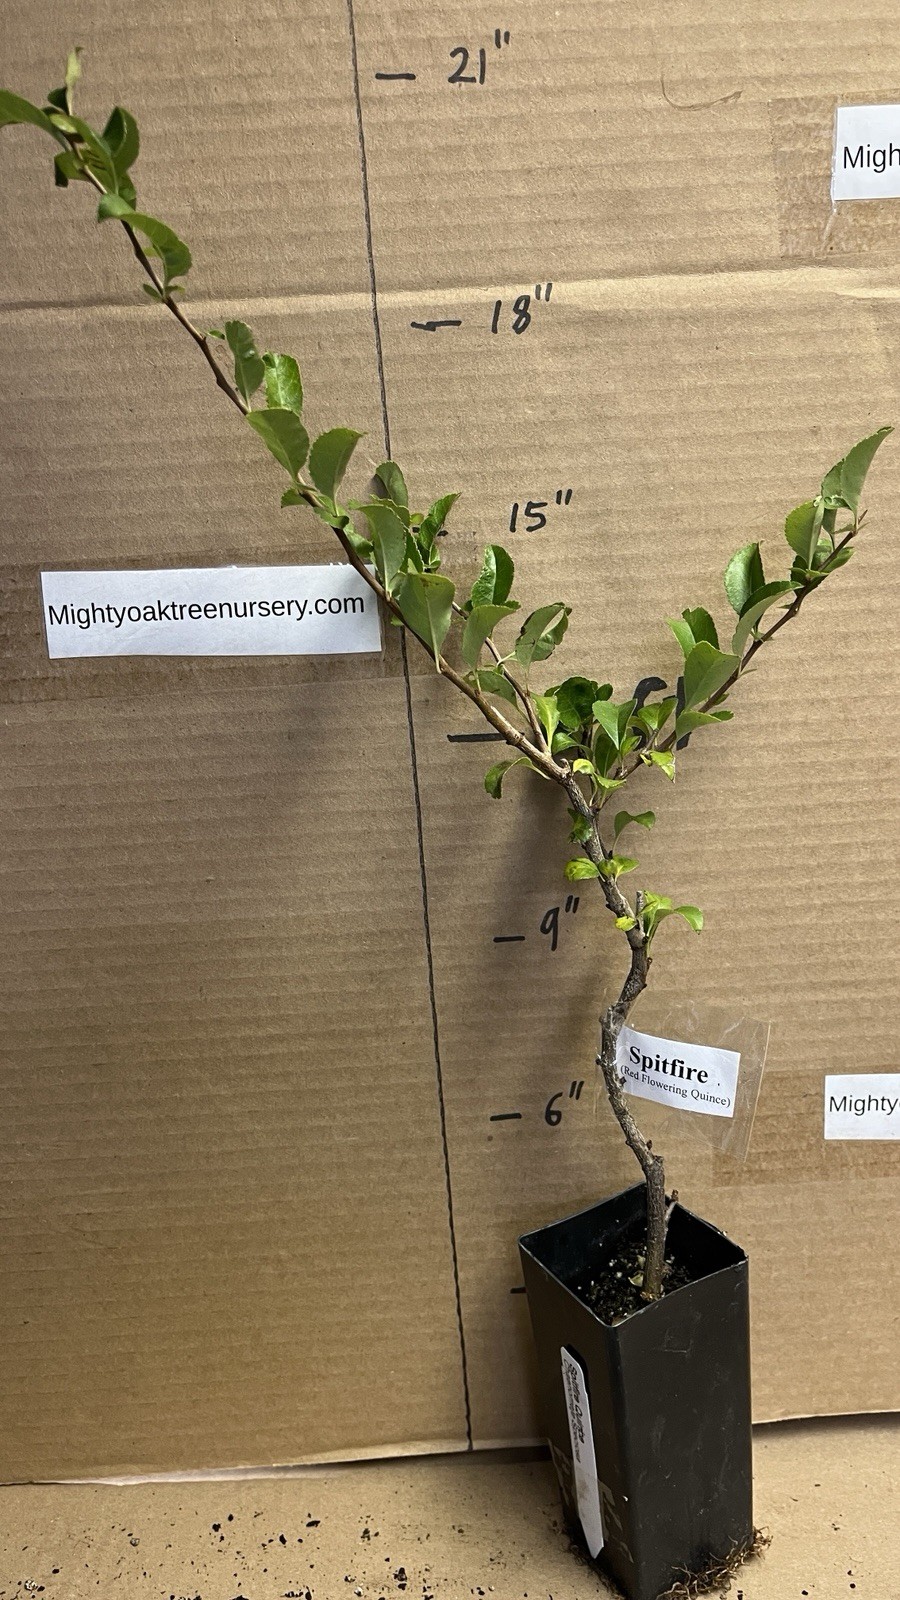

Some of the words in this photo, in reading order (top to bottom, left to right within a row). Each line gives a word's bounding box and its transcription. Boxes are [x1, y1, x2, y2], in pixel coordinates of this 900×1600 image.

[448, 29, 511, 85] 21"
[491, 282, 553, 335] 18"
[509, 488, 573, 533] 15"
[47, 596, 366, 630] Mightyoaktreenursery.com
[540, 895, 580, 952] 9"
[620, 1064, 639, 1081] (Red
[641, 1075, 688, 1098] Flowering
[690, 1088, 731, 1109] Quince)
[629, 1045, 709, 1084] Spitfire
[544, 1080, 584, 1126] 6"
[829, 1094, 900, 1117] Mighty
